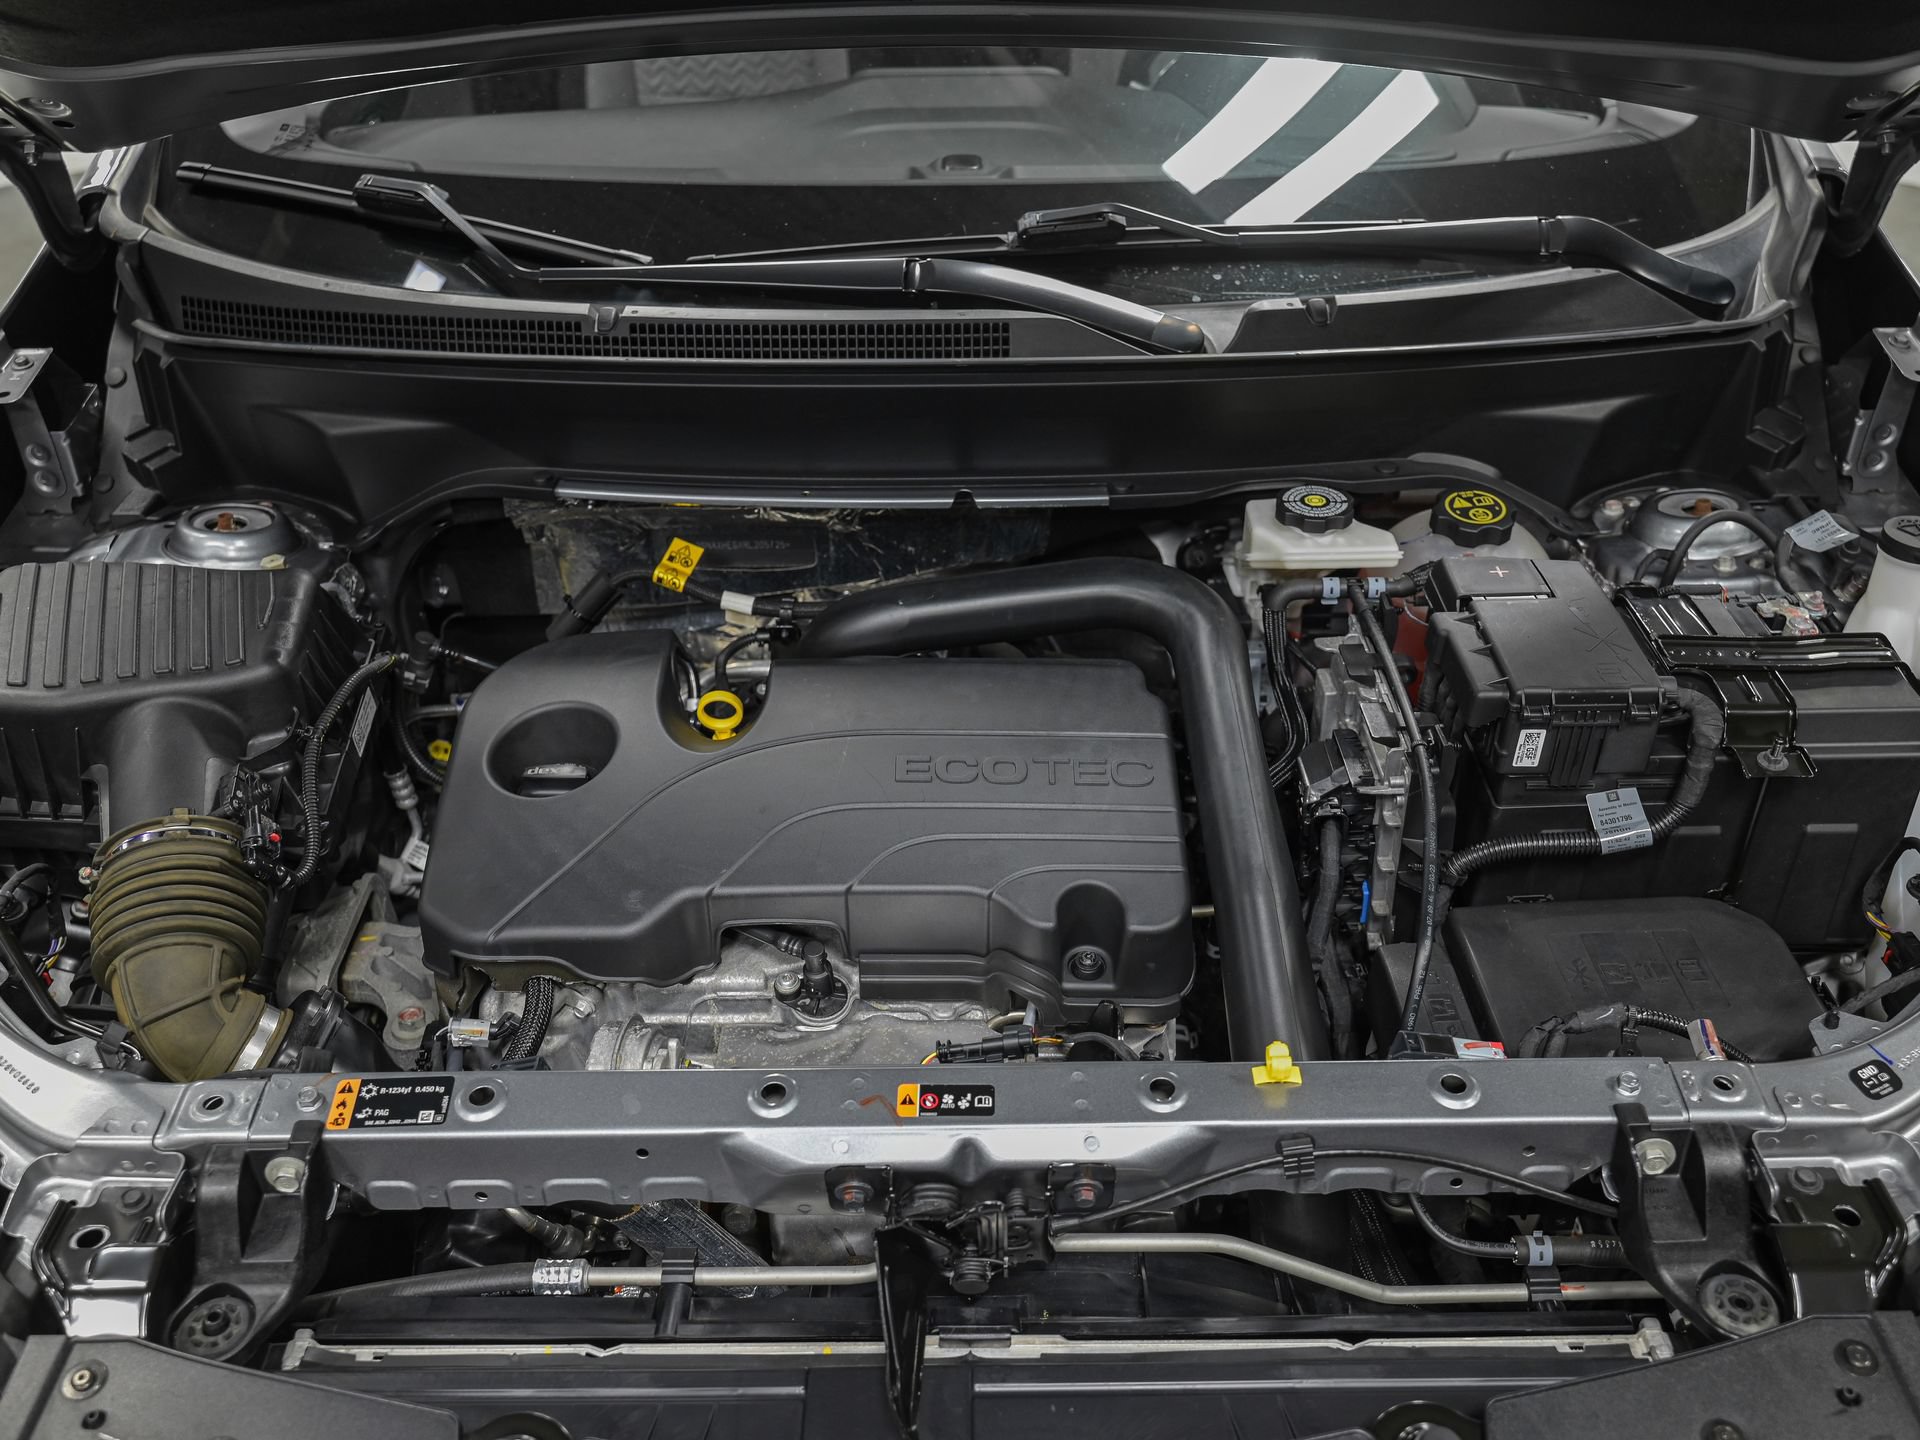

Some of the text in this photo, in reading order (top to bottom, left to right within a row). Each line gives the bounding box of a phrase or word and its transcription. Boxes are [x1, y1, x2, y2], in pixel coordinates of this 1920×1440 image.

[894, 754, 1155, 787] ECOTEC
[1599, 814, 1633, 826] 84301795
[1857, 1065, 1879, 1078] GND
[380, 1086, 412, 1094] R-1234yf
[435, 1085, 445, 1093] kg
